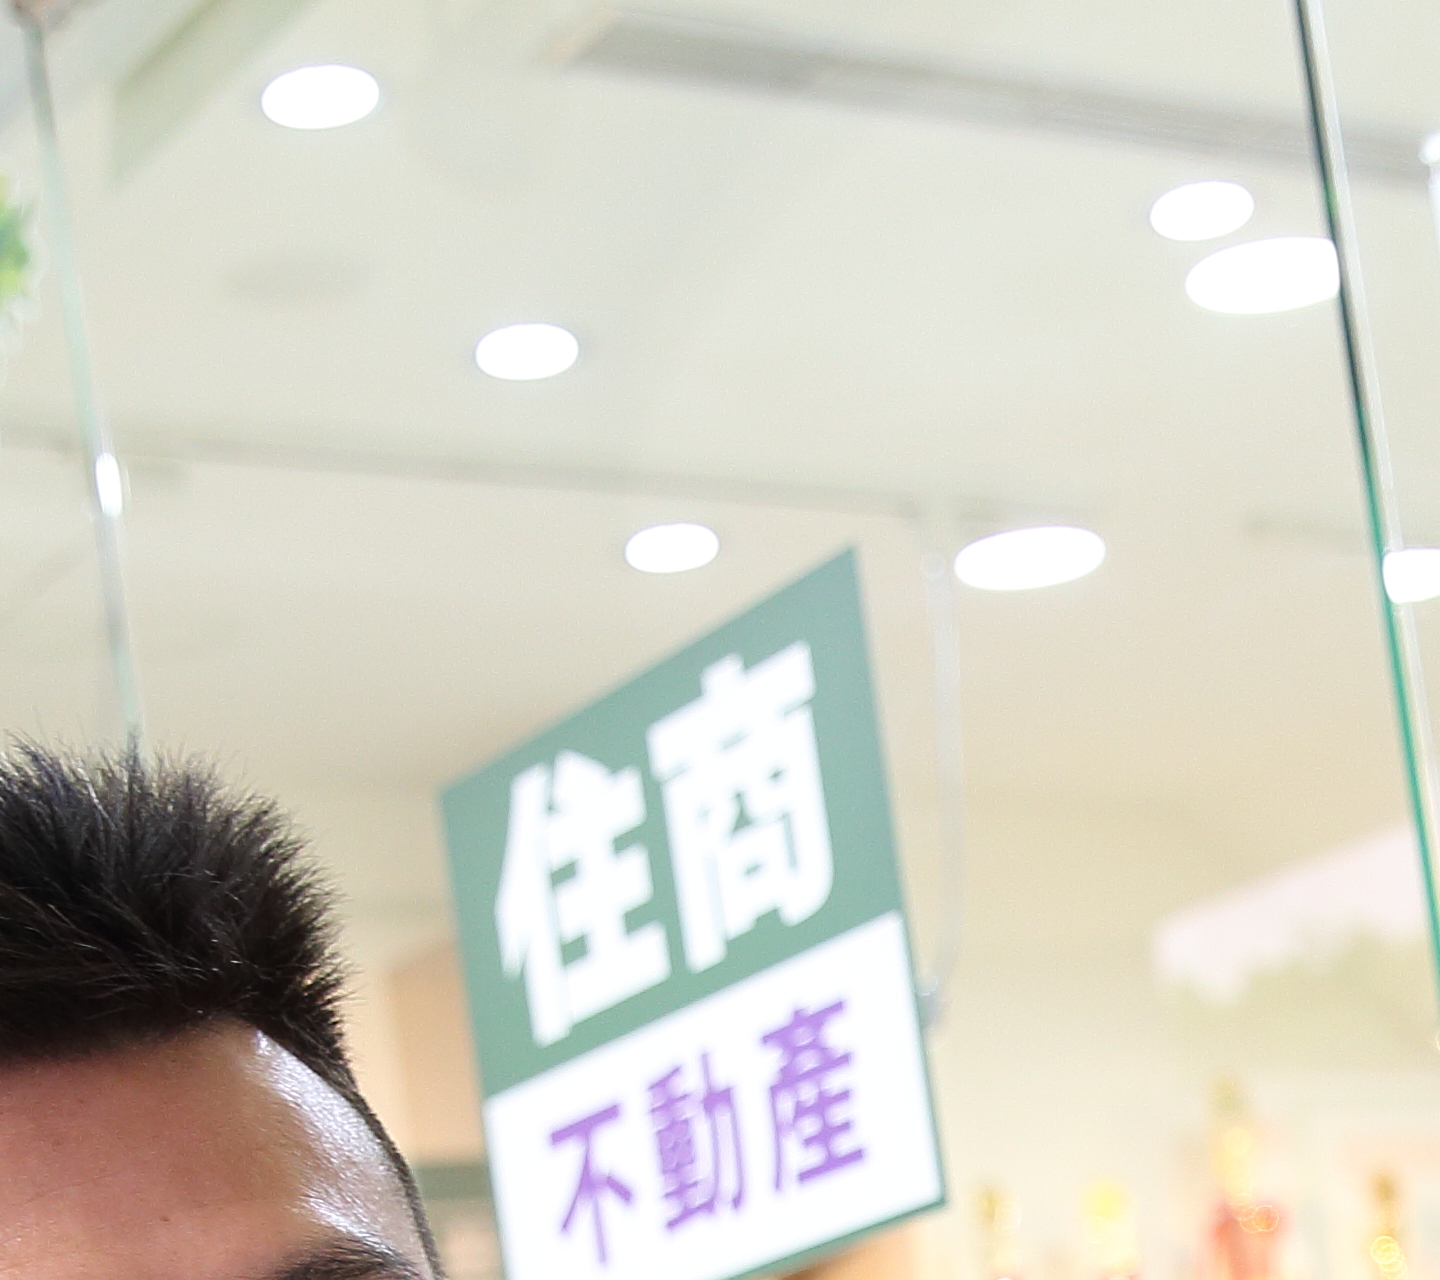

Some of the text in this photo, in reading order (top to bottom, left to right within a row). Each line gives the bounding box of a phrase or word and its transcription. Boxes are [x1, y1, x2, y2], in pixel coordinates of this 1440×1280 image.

[494, 640, 835, 1046] 住商
[547, 998, 867, 1264] 不動產
